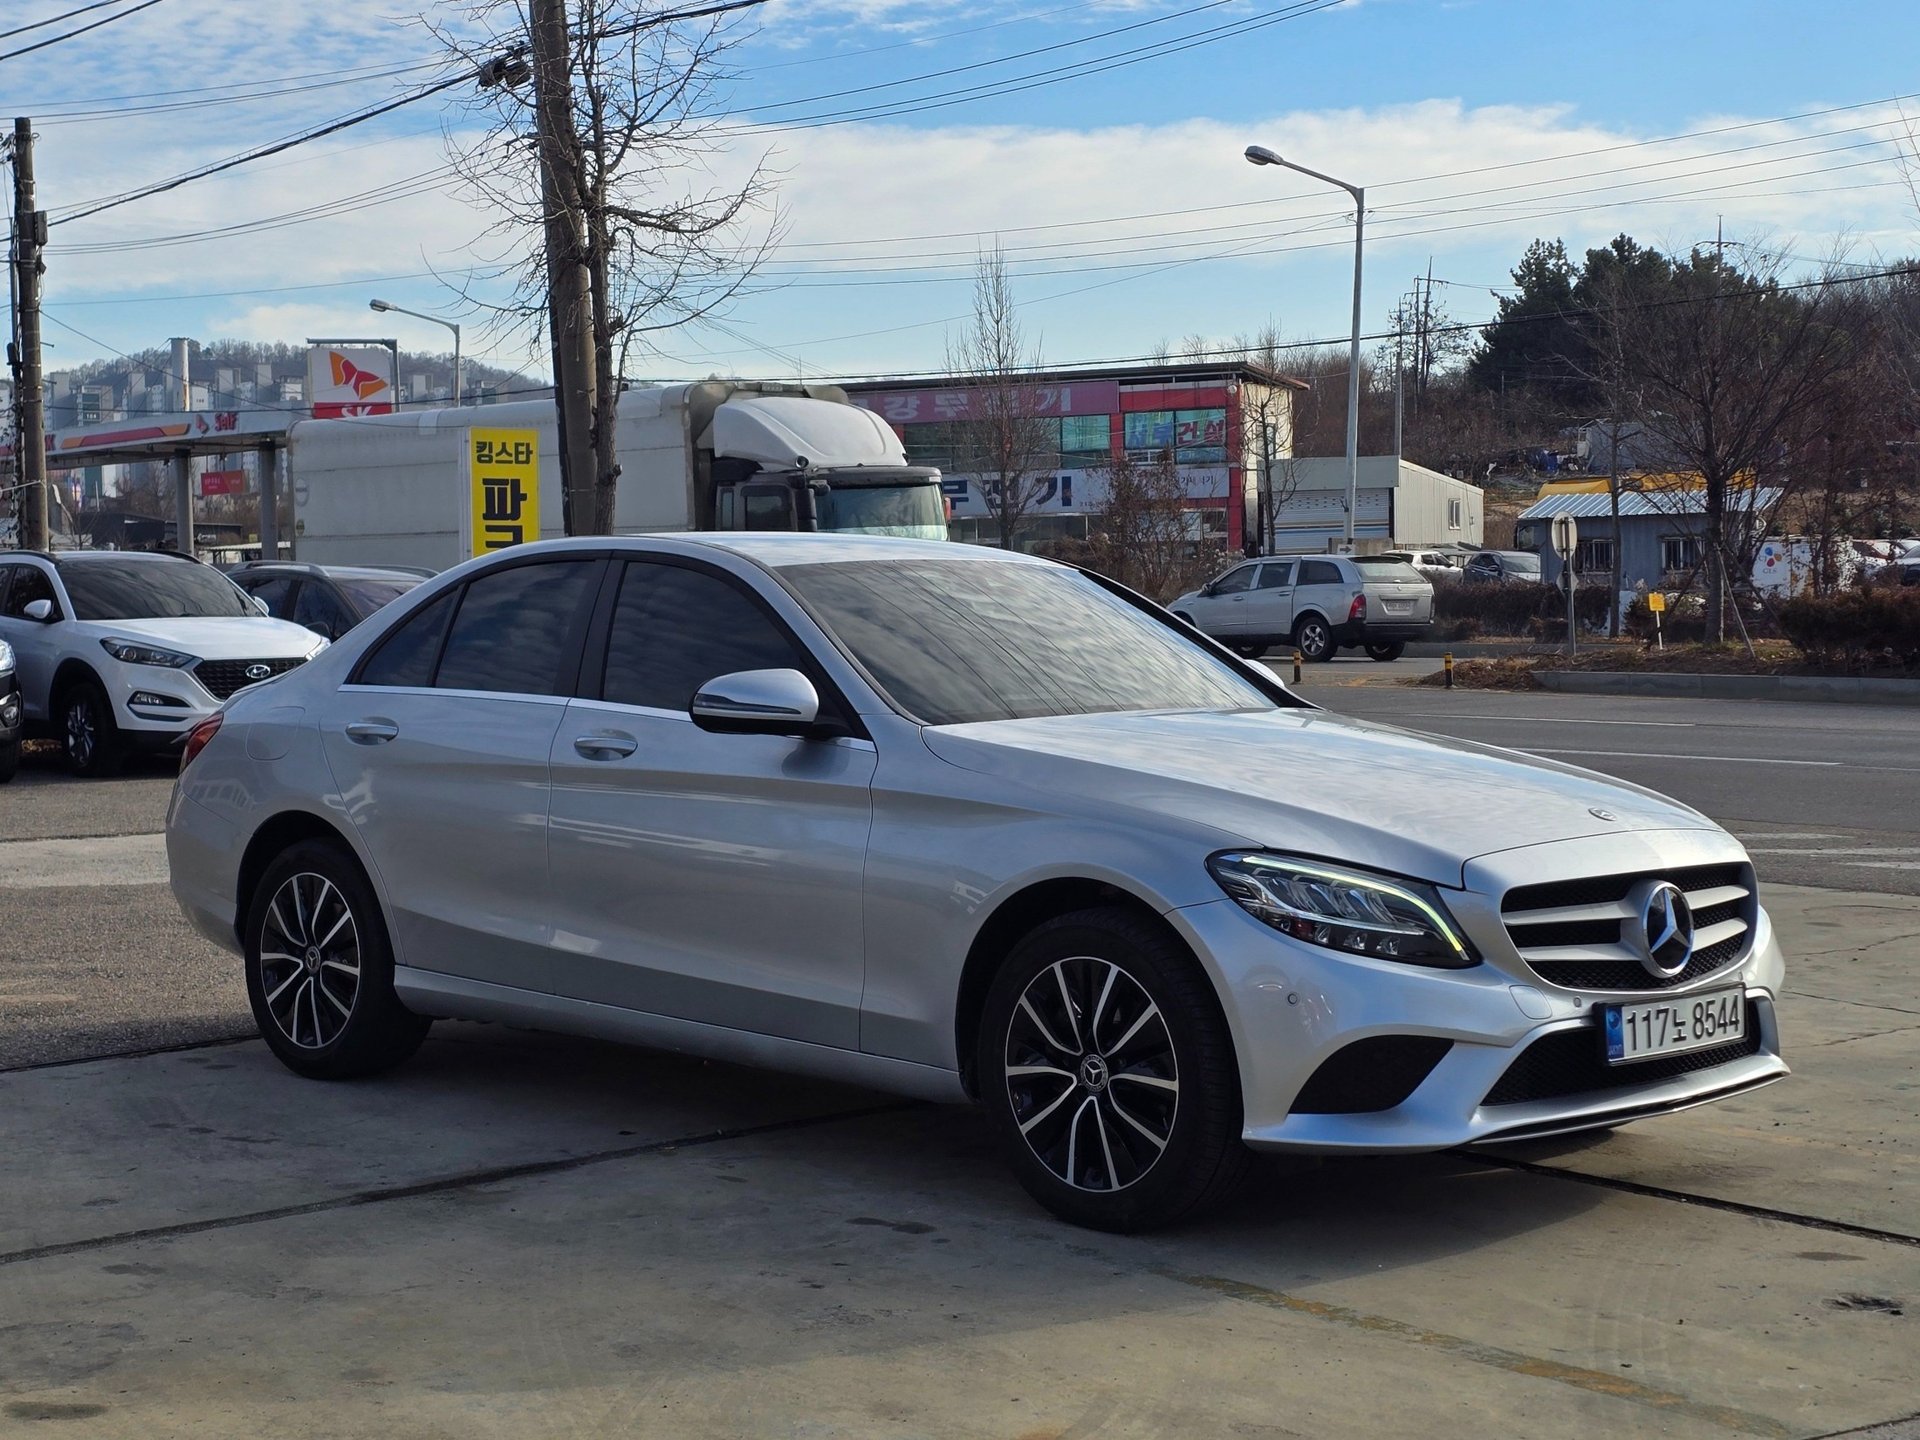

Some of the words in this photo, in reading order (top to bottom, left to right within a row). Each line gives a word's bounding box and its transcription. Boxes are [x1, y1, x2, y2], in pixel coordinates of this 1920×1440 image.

[341, 404, 373, 418] SK
[476, 441, 533, 465] 킹스타
[1626, 1008, 1687, 1051] 117노
[1693, 994, 1740, 1040] 8544
